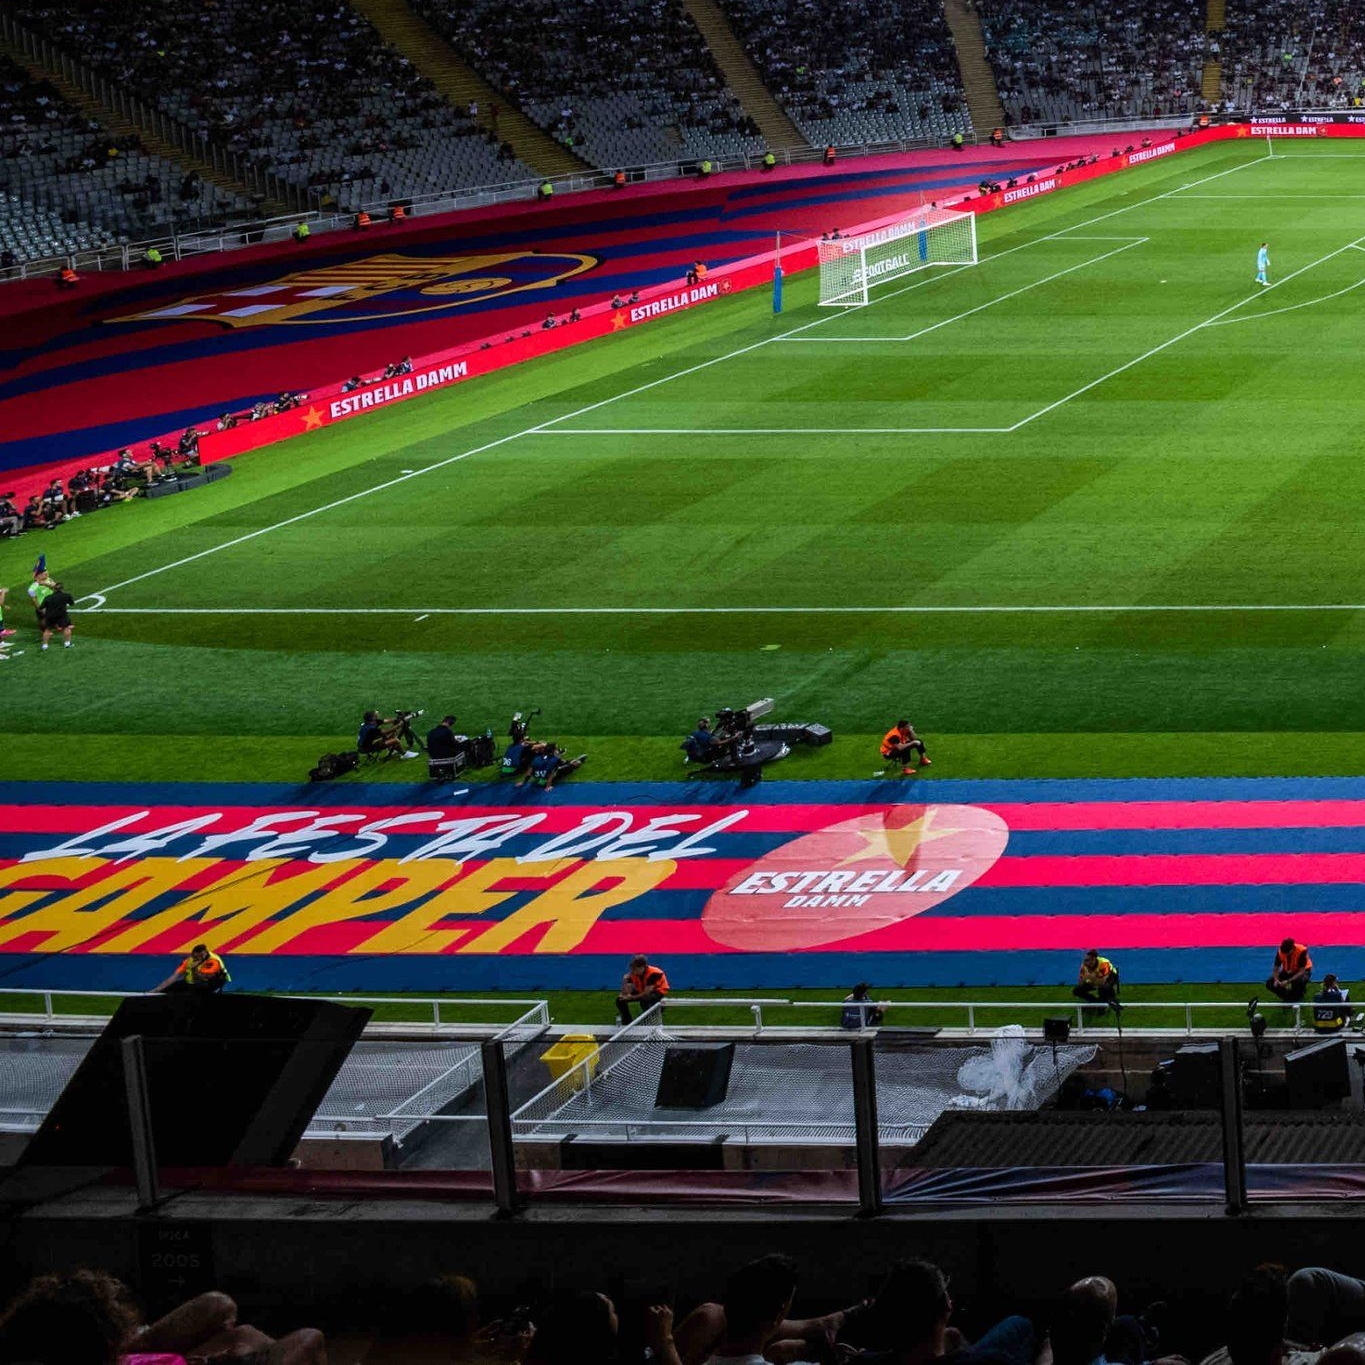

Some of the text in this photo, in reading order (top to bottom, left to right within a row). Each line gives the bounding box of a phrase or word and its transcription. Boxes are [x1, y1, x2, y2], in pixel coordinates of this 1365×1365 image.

[1251, 126, 1295, 135] ESTRELLA
[1129, 142, 1175, 164] ESTRELLA DAMM
[1003, 181, 1039, 203] ESTRELLA
[630, 289, 689, 322] ESTRELLA
[330, 361, 467, 419] ESTRELLA DAMM
[18, 810, 749, 865] LA FESTA DEL
[730, 869, 964, 895] ESTRELLA
[783, 894, 872, 909] DAMM
